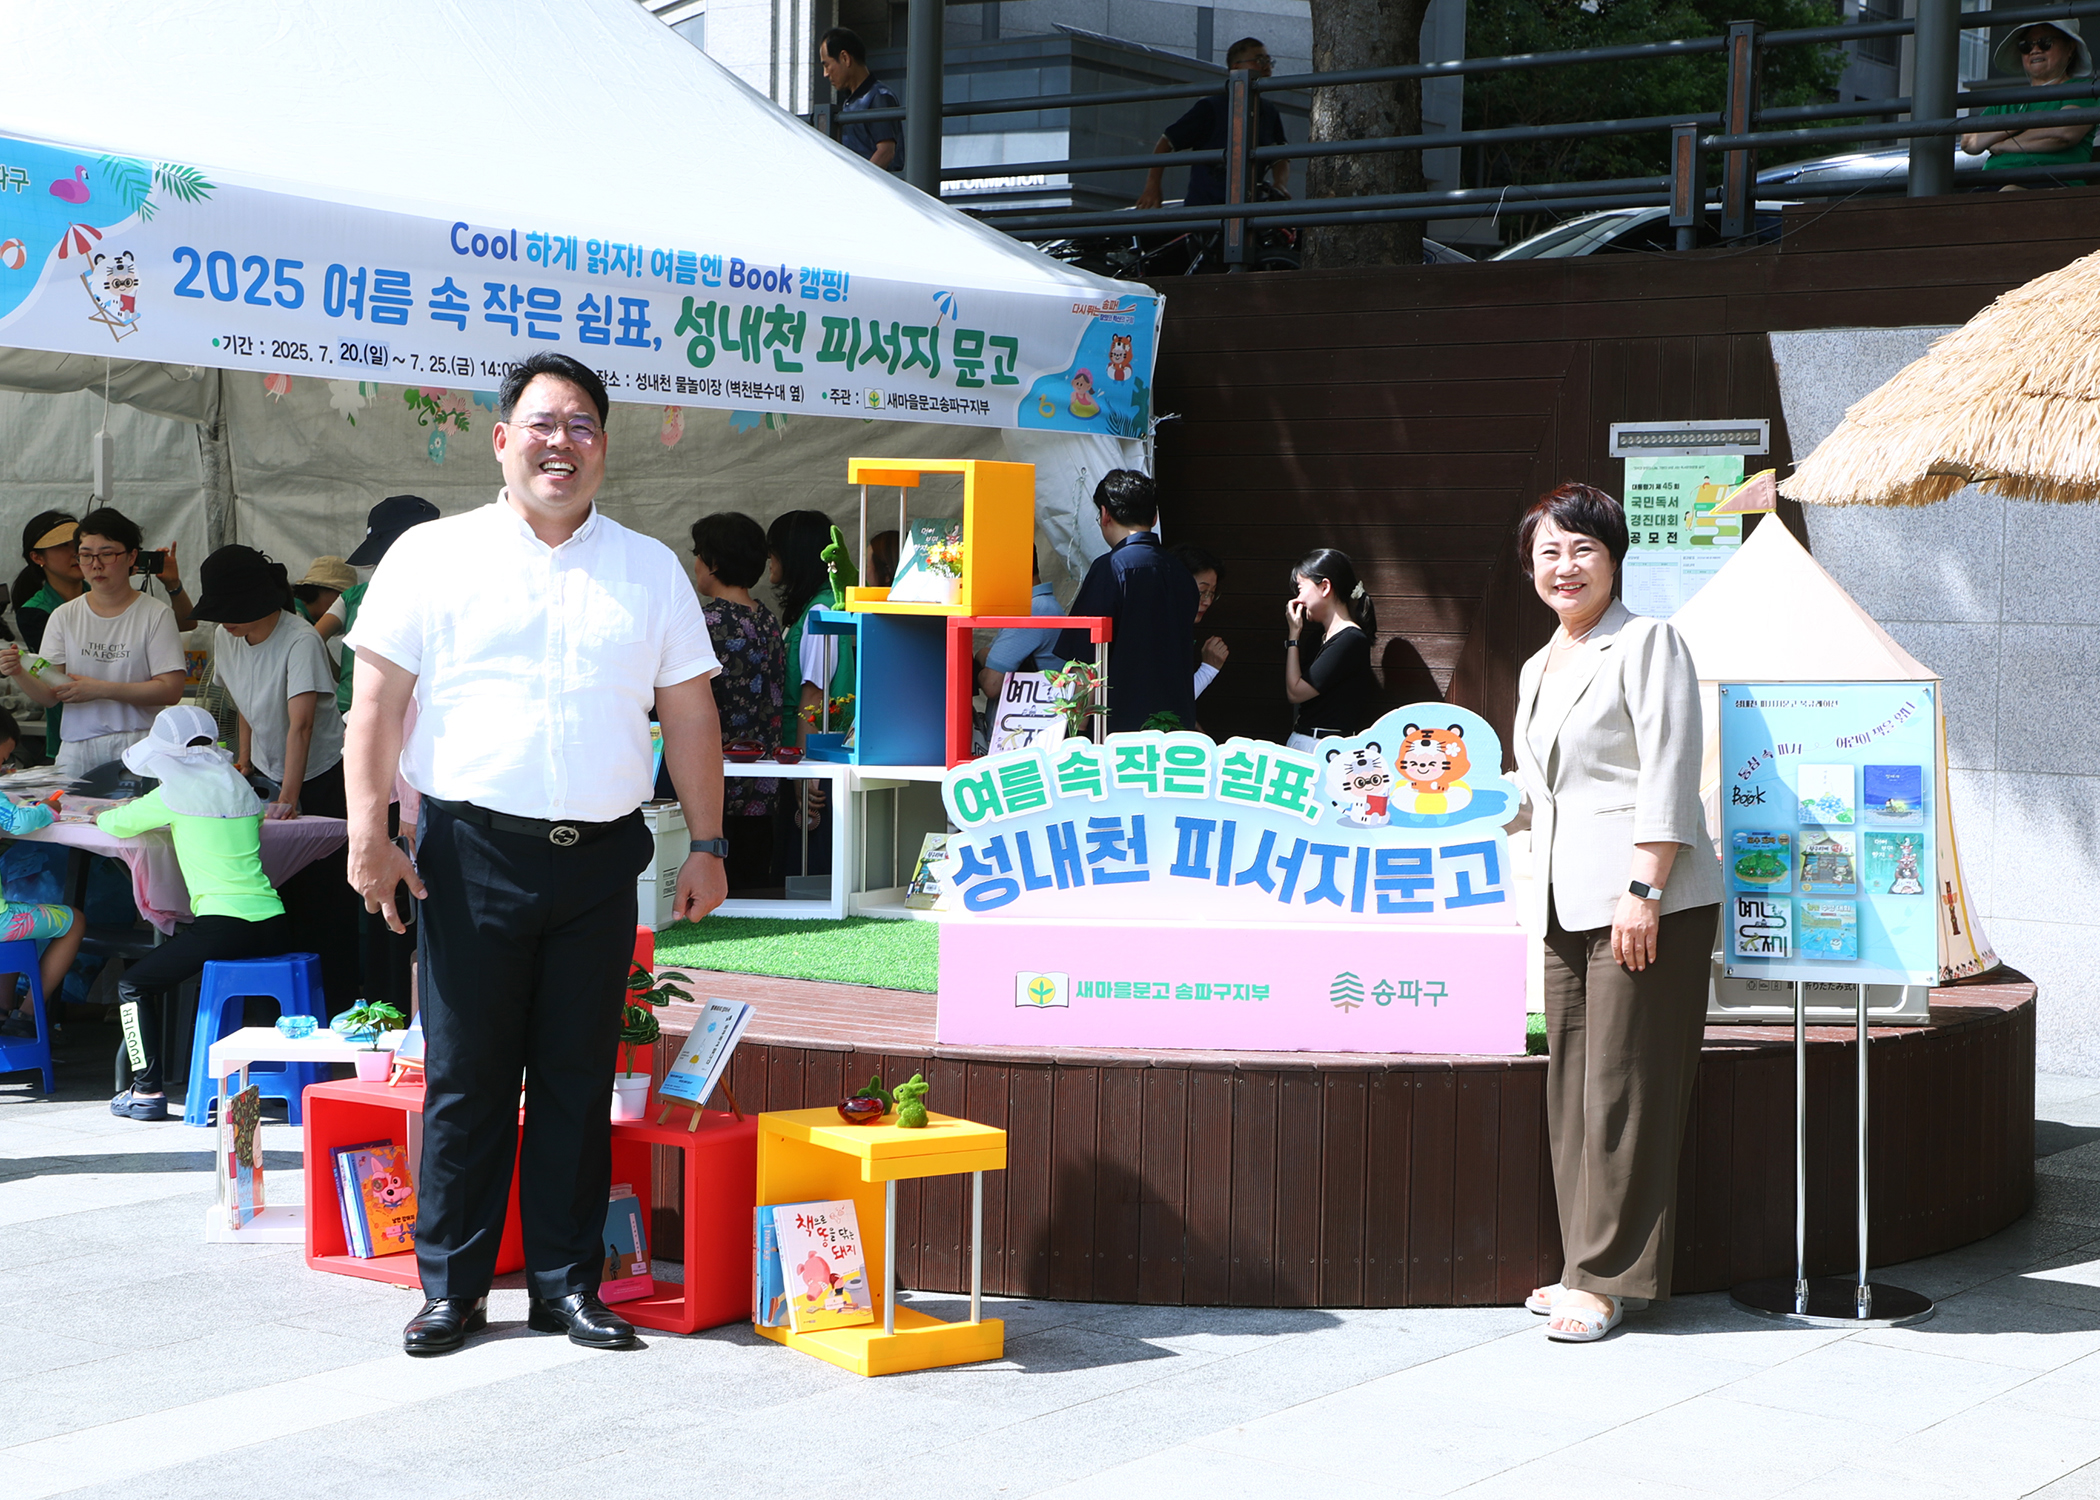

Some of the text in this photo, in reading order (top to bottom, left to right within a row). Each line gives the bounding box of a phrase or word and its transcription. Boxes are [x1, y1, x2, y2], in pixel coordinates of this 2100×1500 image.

[450, 221, 850, 302] Cool 하게 읽자! 여름엔 Book 캠핑!
[172, 246, 1020, 388] 2025 여름 속 작은 쉼표, 성내천 피서지 문고
[222, 335, 253, 356] 기간
[271, 340, 314, 362] 2025.
[318, 345, 333, 364] 7.
[340, 342, 388, 367] 20.(일)
[410, 353, 424, 372] 7.
[429, 355, 475, 377] 25.(금)
[635, 373, 672, 393] 성내천
[675, 375, 722, 396] 물놀이장
[830, 388, 851, 406] 주관
[887, 393, 990, 415] 새마을문고송파구지부
[1631, 496, 1679, 509] 국민독서
[1631, 514, 1678, 527] 경진대회
[89, 642, 106, 650] THE
[101, 650, 131, 659] FOREST
[1836, 732, 1871, 749] 어린이
[953, 744, 1318, 822] 여름 속 작은 쉼표,
[1732, 785, 1766, 806] Book
[952, 814, 1505, 914] 성내천 피서지문고
[1076, 981, 1270, 1002] 새마을문고 송파구지부
[1370, 979, 1448, 1007] 송파구
[795, 1213, 827, 1237] 책으로
[817, 1227, 854, 1248] 똥을 닦는
[831, 1245, 856, 1260] 돼지
